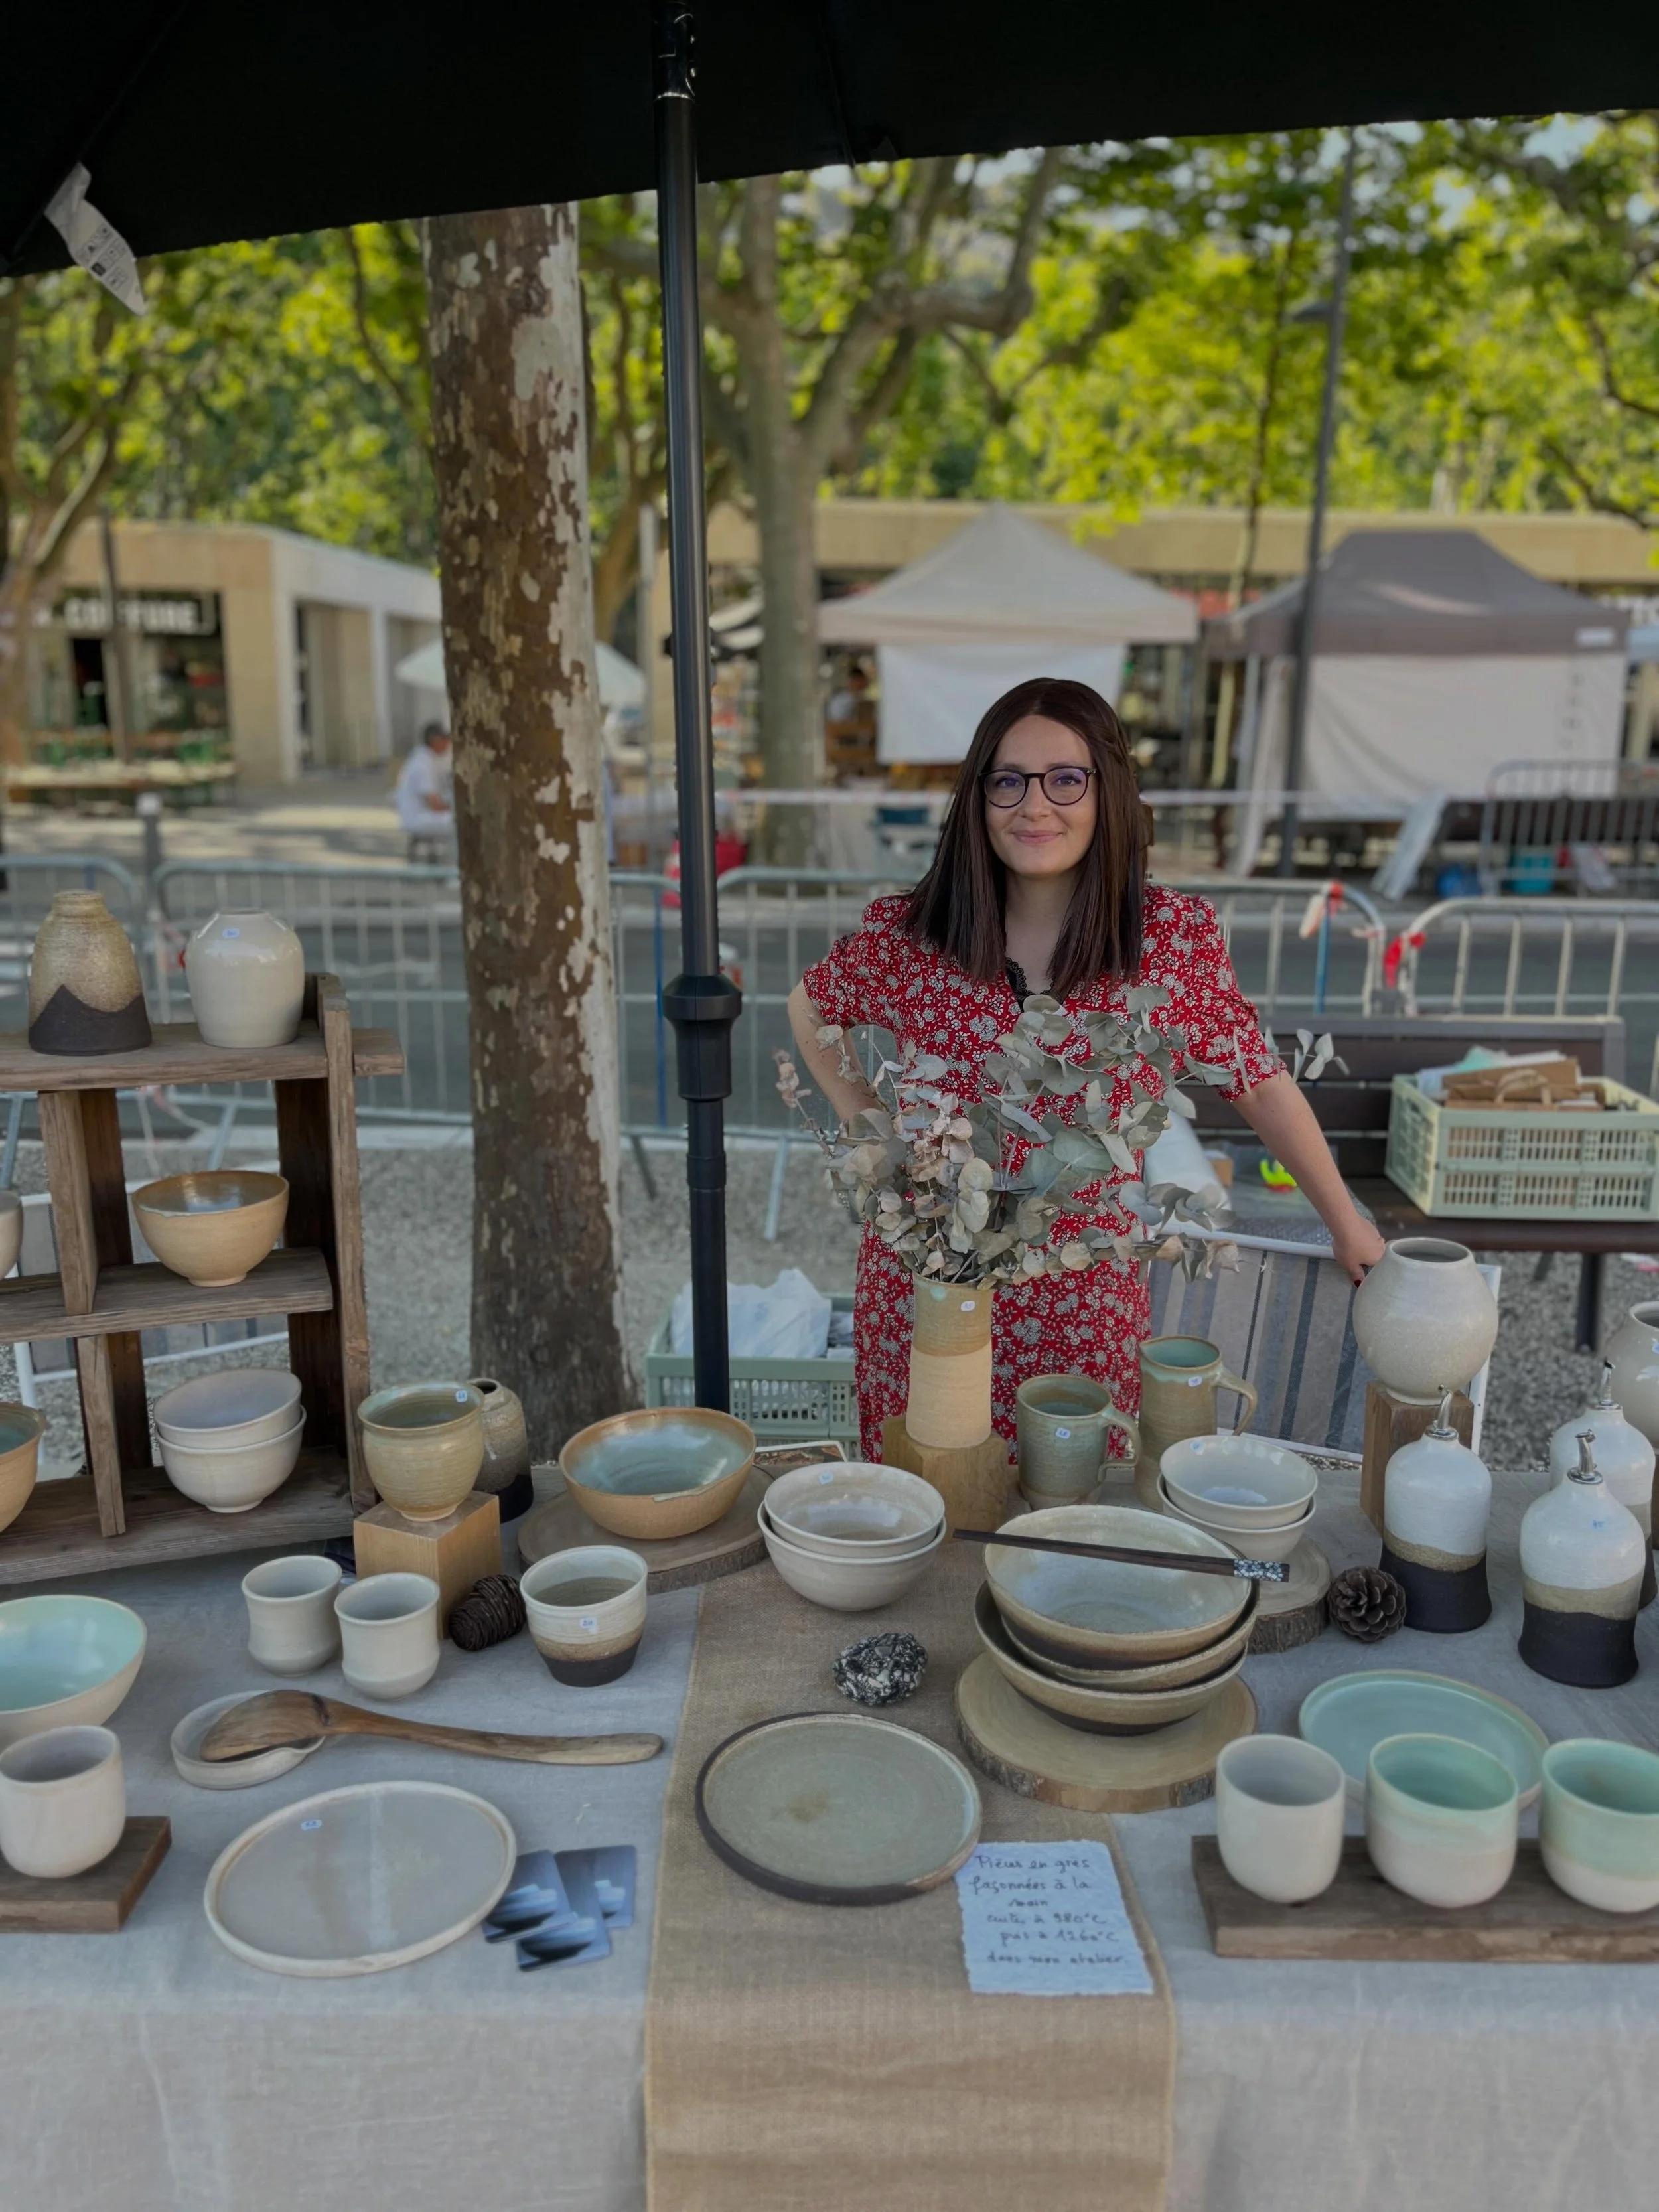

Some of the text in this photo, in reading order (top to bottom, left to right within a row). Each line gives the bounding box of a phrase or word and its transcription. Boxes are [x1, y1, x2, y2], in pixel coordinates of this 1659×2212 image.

[975, 1855, 1090, 1873] Pièces en grès
[1054, 1880, 1066, 1889] à
[1072, 1876, 1092, 1889] la
[1008, 1899, 1048, 1907] main
[1034, 1915, 1044, 1924] à
[1000, 1931, 1029, 1947] puis
[1038, 1931, 1047, 1939] à
[987, 1951, 1021, 1964] dans
